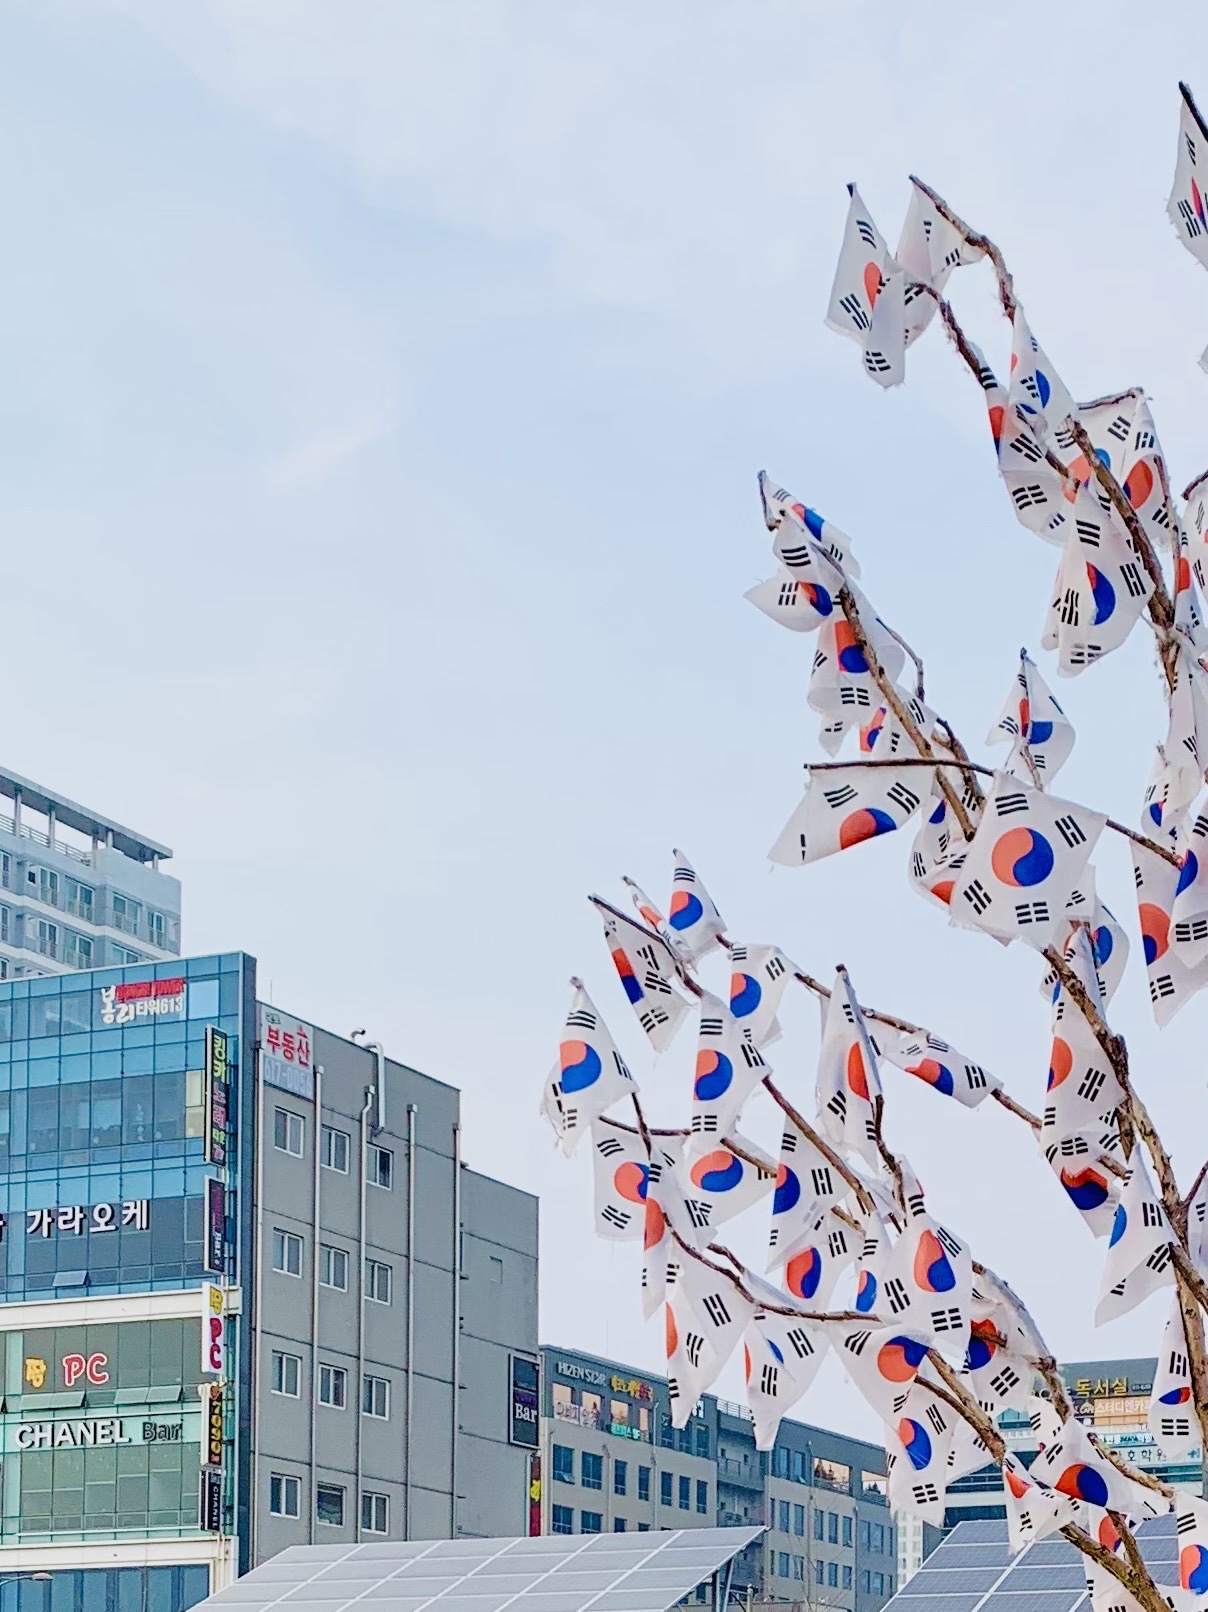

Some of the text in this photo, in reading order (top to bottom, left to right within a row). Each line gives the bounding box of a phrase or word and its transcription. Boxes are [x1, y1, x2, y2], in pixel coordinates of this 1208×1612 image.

[266, 1025, 311, 1068] 부동산
[26, 1200, 149, 1238] 가라오케
[63, 1353, 109, 1388] PC
[1076, 1377, 1129, 1398] 독서실
[514, 1402, 538, 1424] Bar
[15, 1420, 184, 1449] CHANEL Bar
